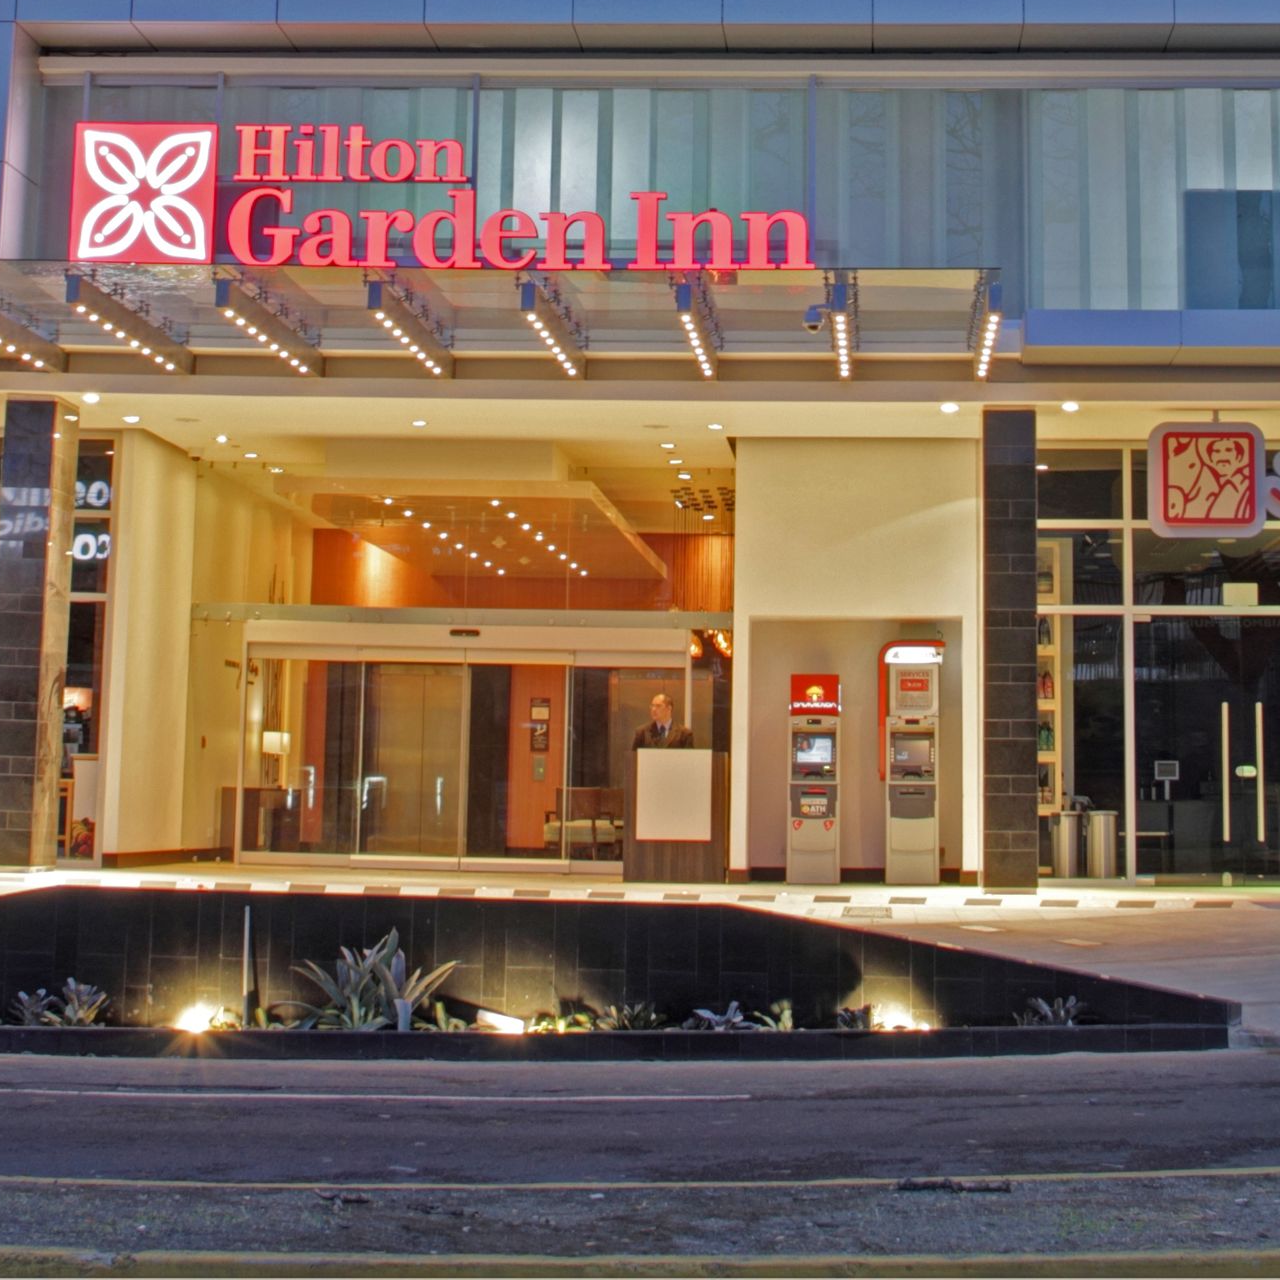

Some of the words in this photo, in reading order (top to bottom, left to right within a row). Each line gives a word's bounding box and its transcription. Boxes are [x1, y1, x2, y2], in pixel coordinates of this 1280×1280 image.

[232, 124, 467, 182] Hilton
[226, 187, 612, 270] Garden
[627, 191, 816, 270] Inn
